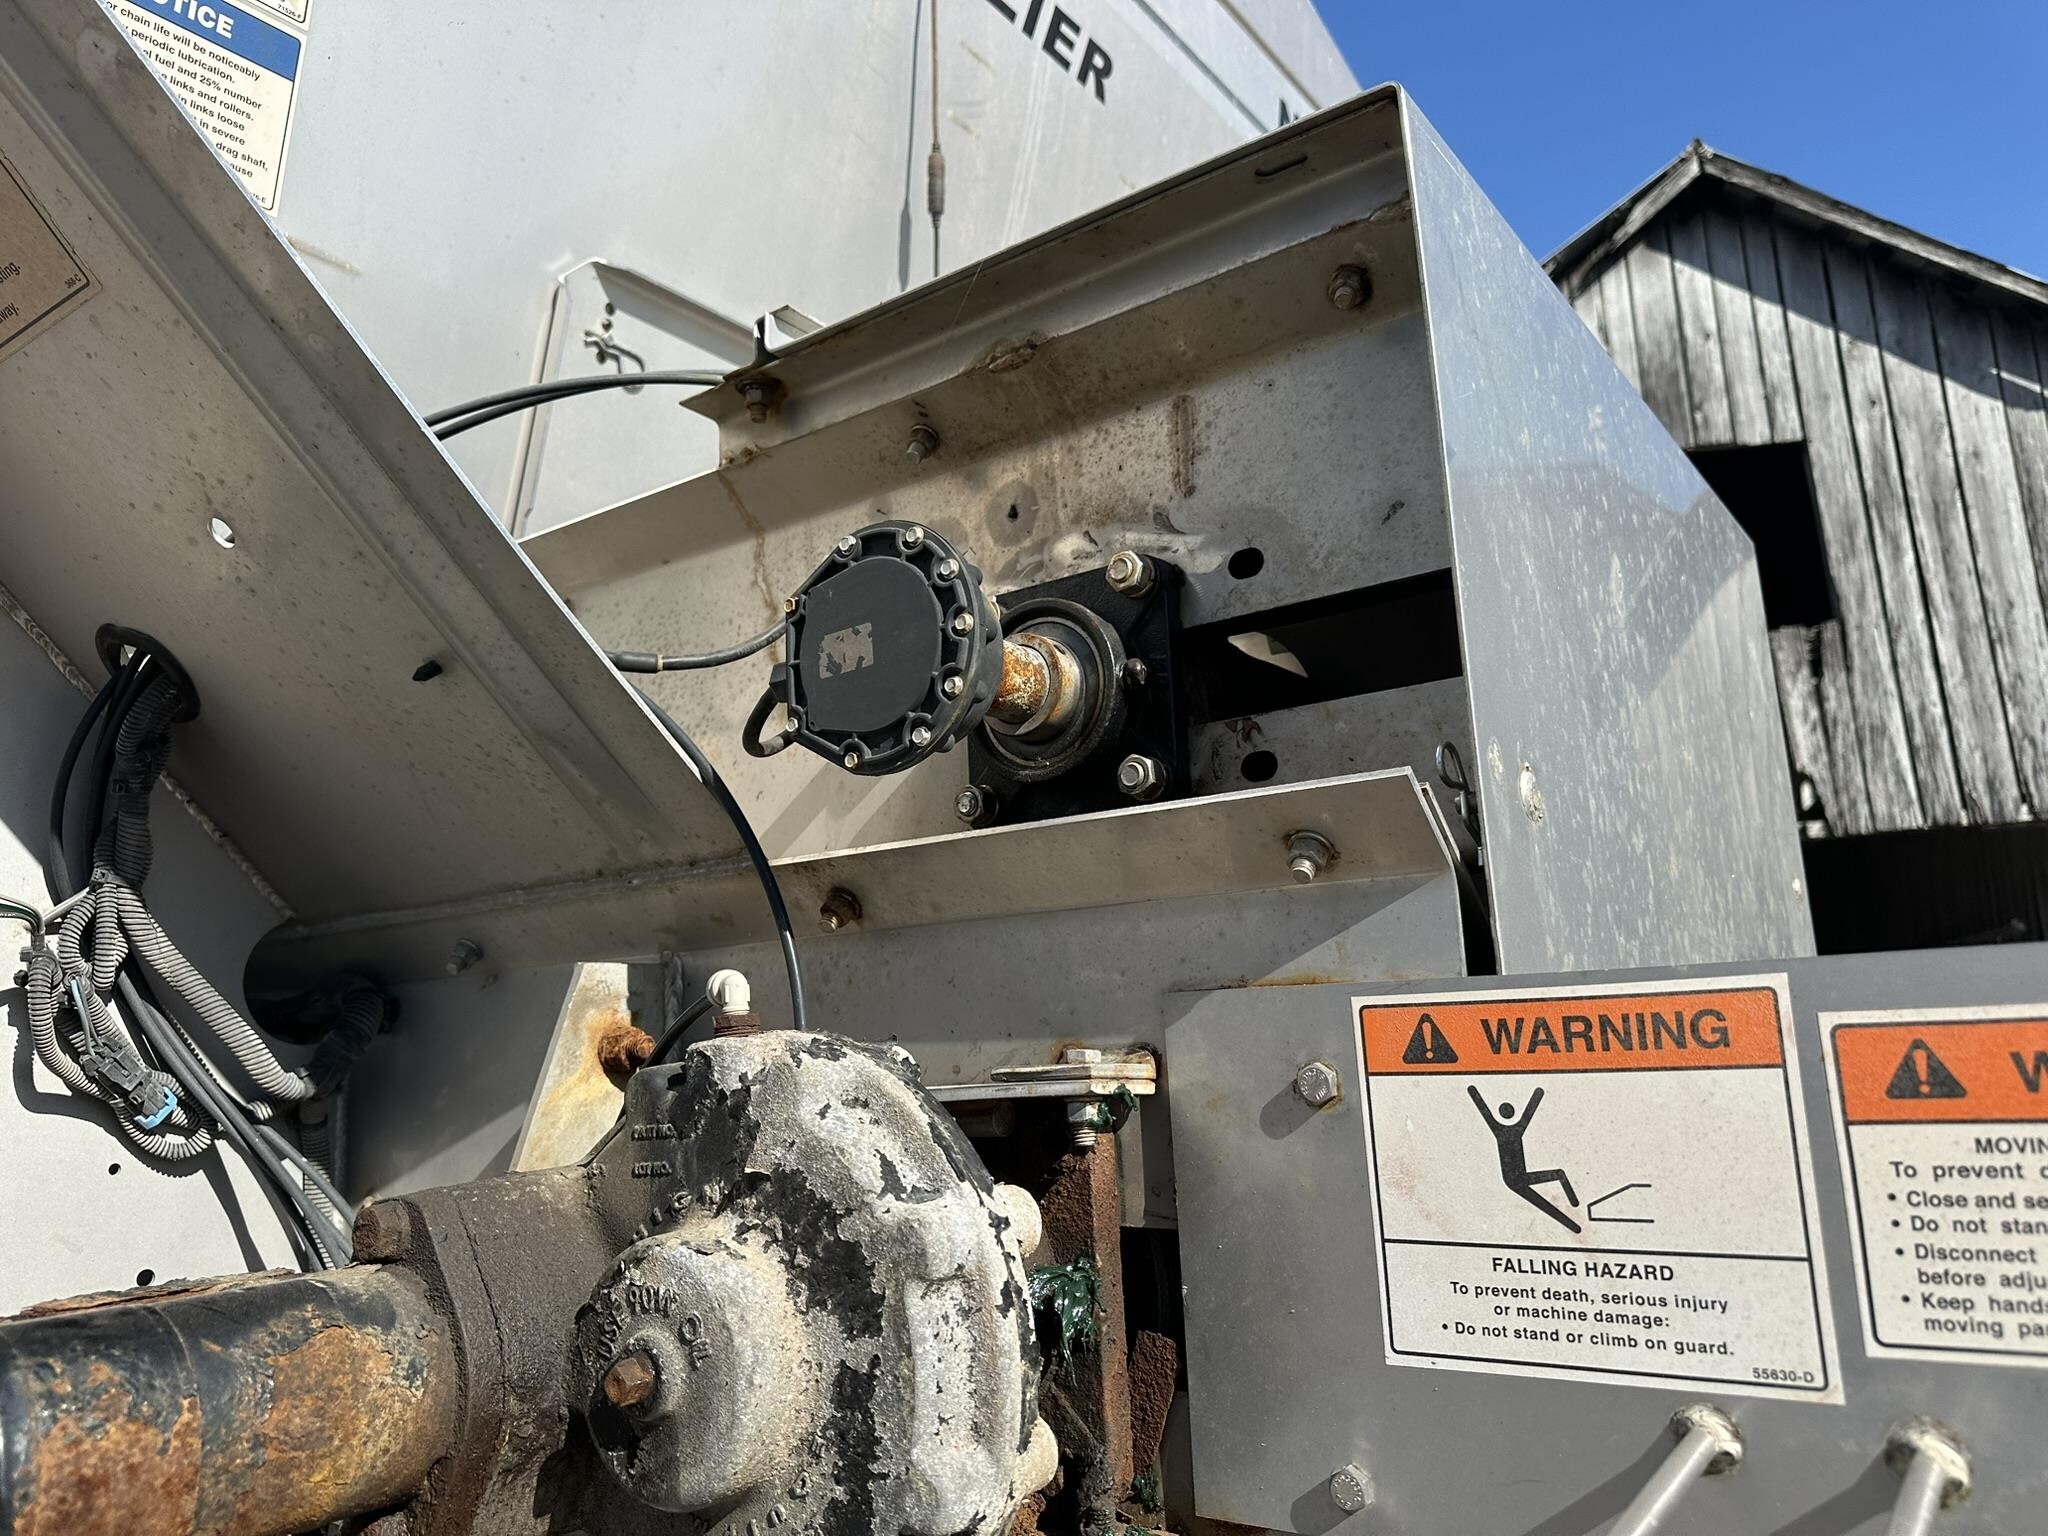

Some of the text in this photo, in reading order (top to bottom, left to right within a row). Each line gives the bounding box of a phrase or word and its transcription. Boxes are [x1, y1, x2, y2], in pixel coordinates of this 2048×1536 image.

[120, 7, 151, 29] chain
[153, 22, 171, 37] life
[172, 32, 191, 48] will
[193, 41, 207, 55] be
[208, 50, 261, 82] noticeably
[131, 28, 236, 84] periodic lubrication.
[155, 53, 175, 70] fuel
[177, 65, 198, 80] and
[199, 74, 221, 92] 25%
[223, 87, 263, 110] number
[169, 75, 254, 121] links and rollers.
[190, 99, 215, 118] links
[217, 112, 246, 132] loose
[199, 118, 246, 146] in severe
[215, 141, 269, 172] drag shaft,
[1480, 1008, 1732, 1055] WARNING
[1889, 1161, 1918, 1178] To
[1932, 1163, 2024, 1183] prevent
[1906, 1190, 2048, 1210] Close and se
[1910, 1215, 2048, 1235] Do not stan
[1914, 1243, 2037, 1264] Disconnect
[1492, 1257, 1674, 1281] FALLING HAZARD
[1917, 1268, 2048, 1293] before adju
[1450, 1281, 1728, 1314] To prevent death, serious injury
[1920, 1291, 1975, 1315] Keep
[1494, 1305, 1671, 1329] or machine damage:
[1923, 1316, 2005, 1339] moving
[1454, 1321, 1735, 1356] Do not stand or climb on guard.
[1752, 1367, 1815, 1384] 55630-D
